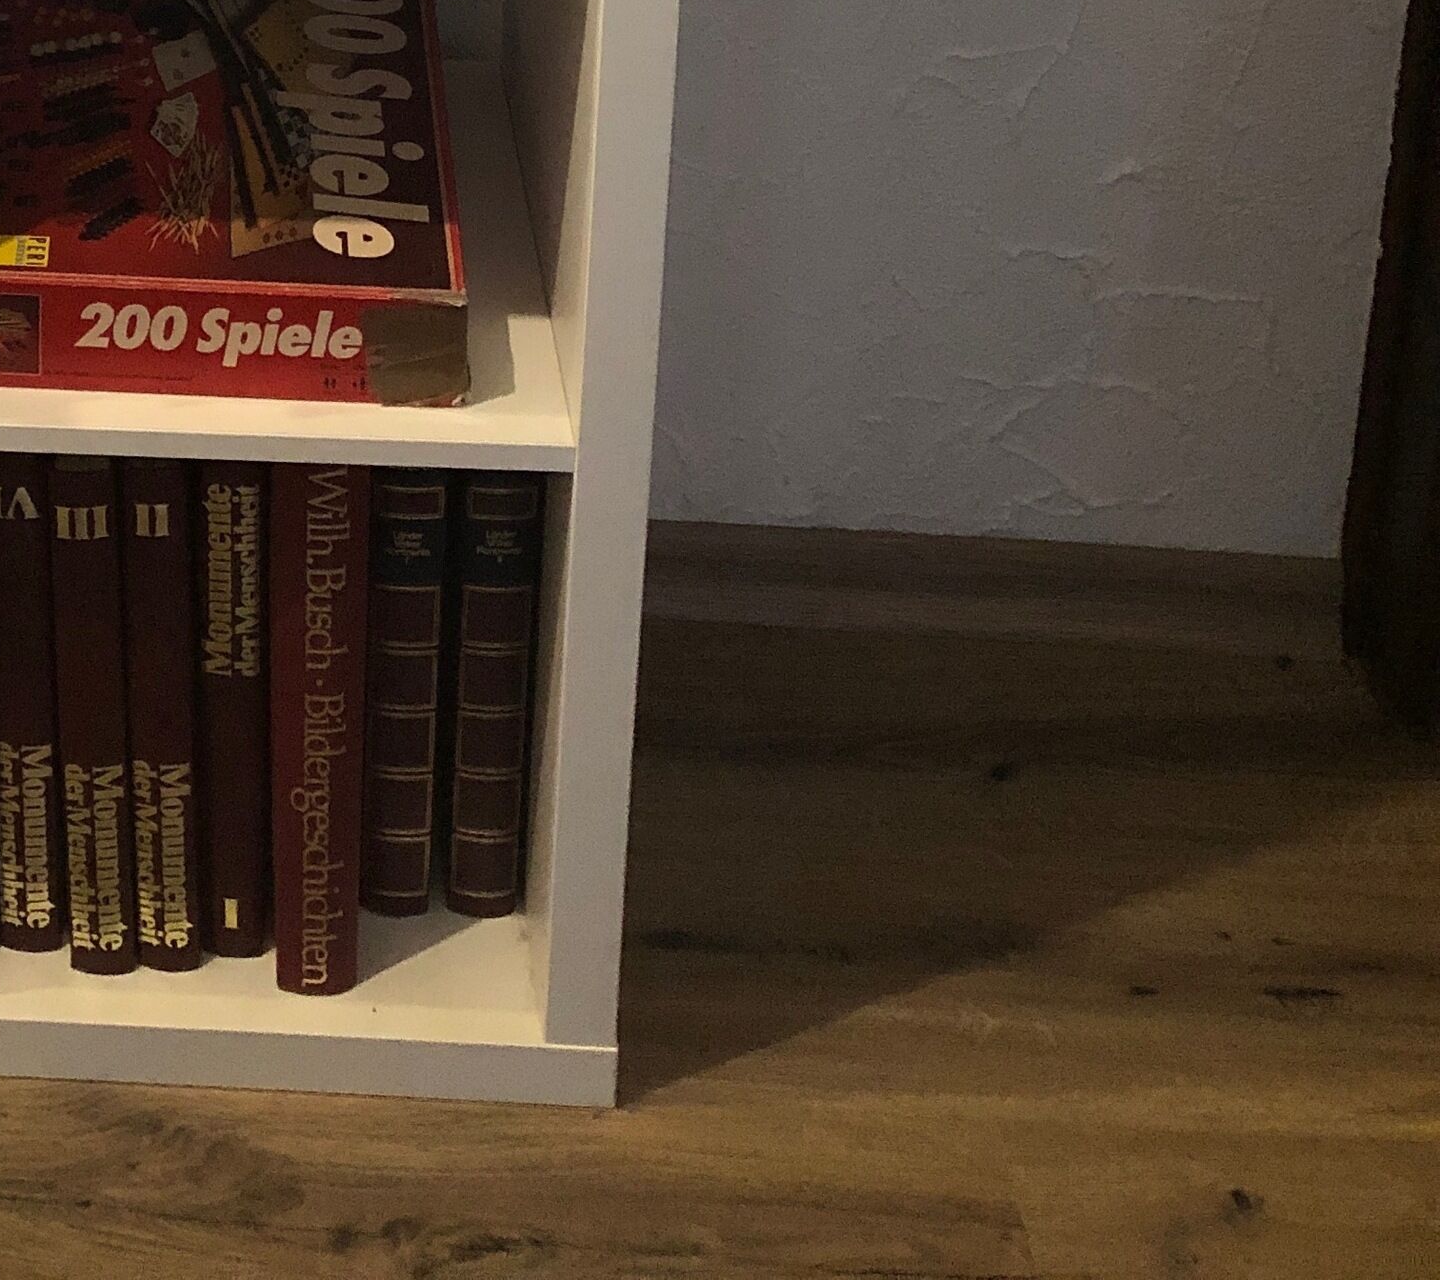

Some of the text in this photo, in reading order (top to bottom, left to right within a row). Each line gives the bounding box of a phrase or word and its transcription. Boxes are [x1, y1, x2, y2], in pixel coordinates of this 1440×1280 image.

[274, 61, 430, 259] Spiele
[74, 301, 363, 368] 200 Spiele
[54, 504, 110, 541] III
[134, 503, 171, 538] II
[200, 483, 233, 678] Monumente
[231, 484, 261, 678] der Menschheit
[305, 565, 348, 671] Busch
[21, 743, 57, 930] Monumente
[64, 763, 99, 951] der Menschheit
[91, 763, 129, 952] Monumente
[133, 760, 164, 947] der Menschheit
[159, 762, 194, 949] Monumente
[291, 692, 346, 988] Bildergeschichten
